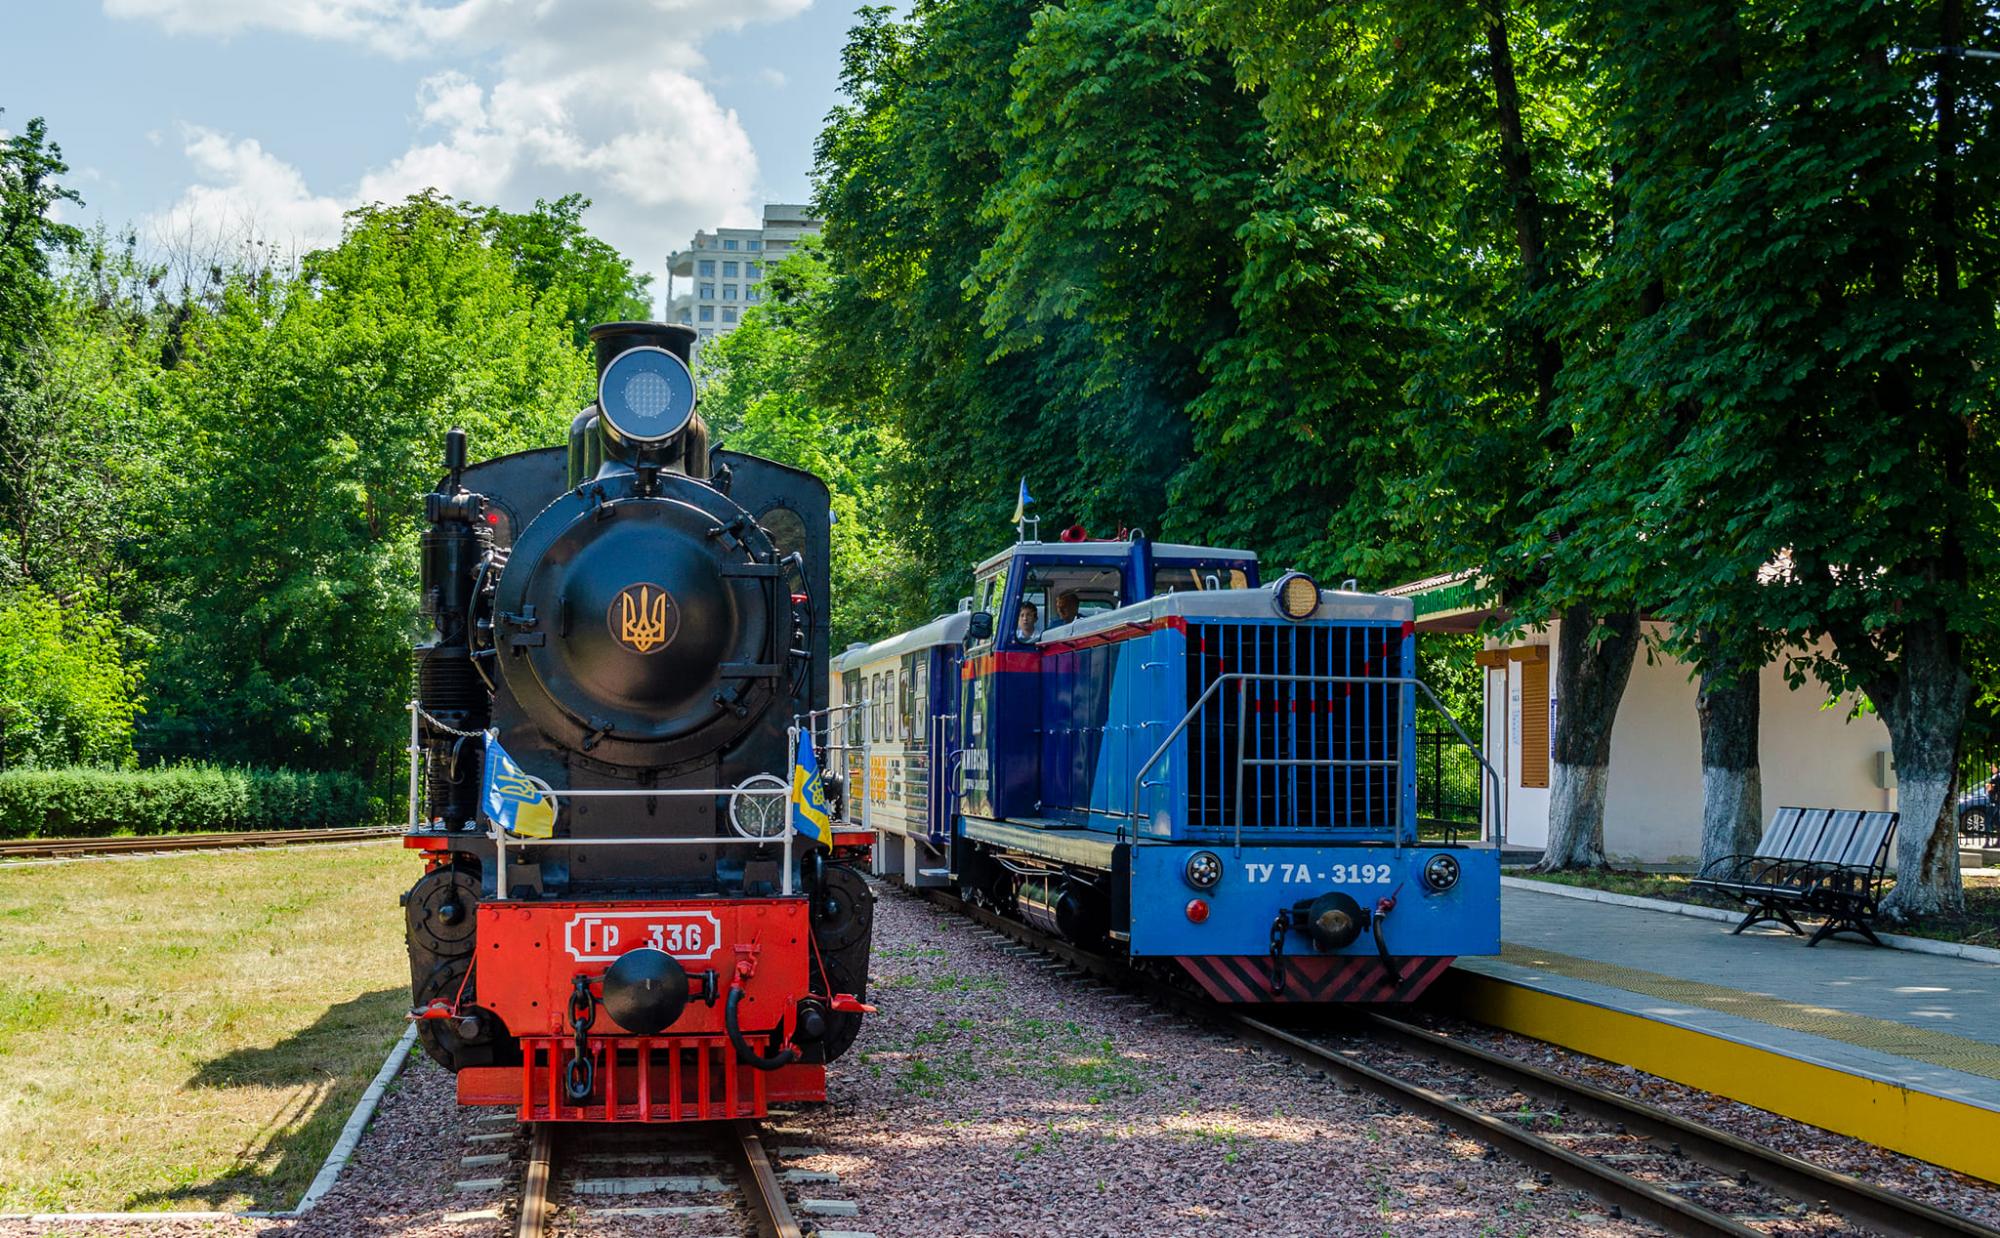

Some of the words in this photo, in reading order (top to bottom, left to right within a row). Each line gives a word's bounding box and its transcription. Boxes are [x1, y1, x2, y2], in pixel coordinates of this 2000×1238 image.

[1245, 863, 1274, 883] ТУ
[1281, 863, 1312, 883] 7А
[1331, 863, 1391, 884] 3192
[648, 924, 701, 951] 336
